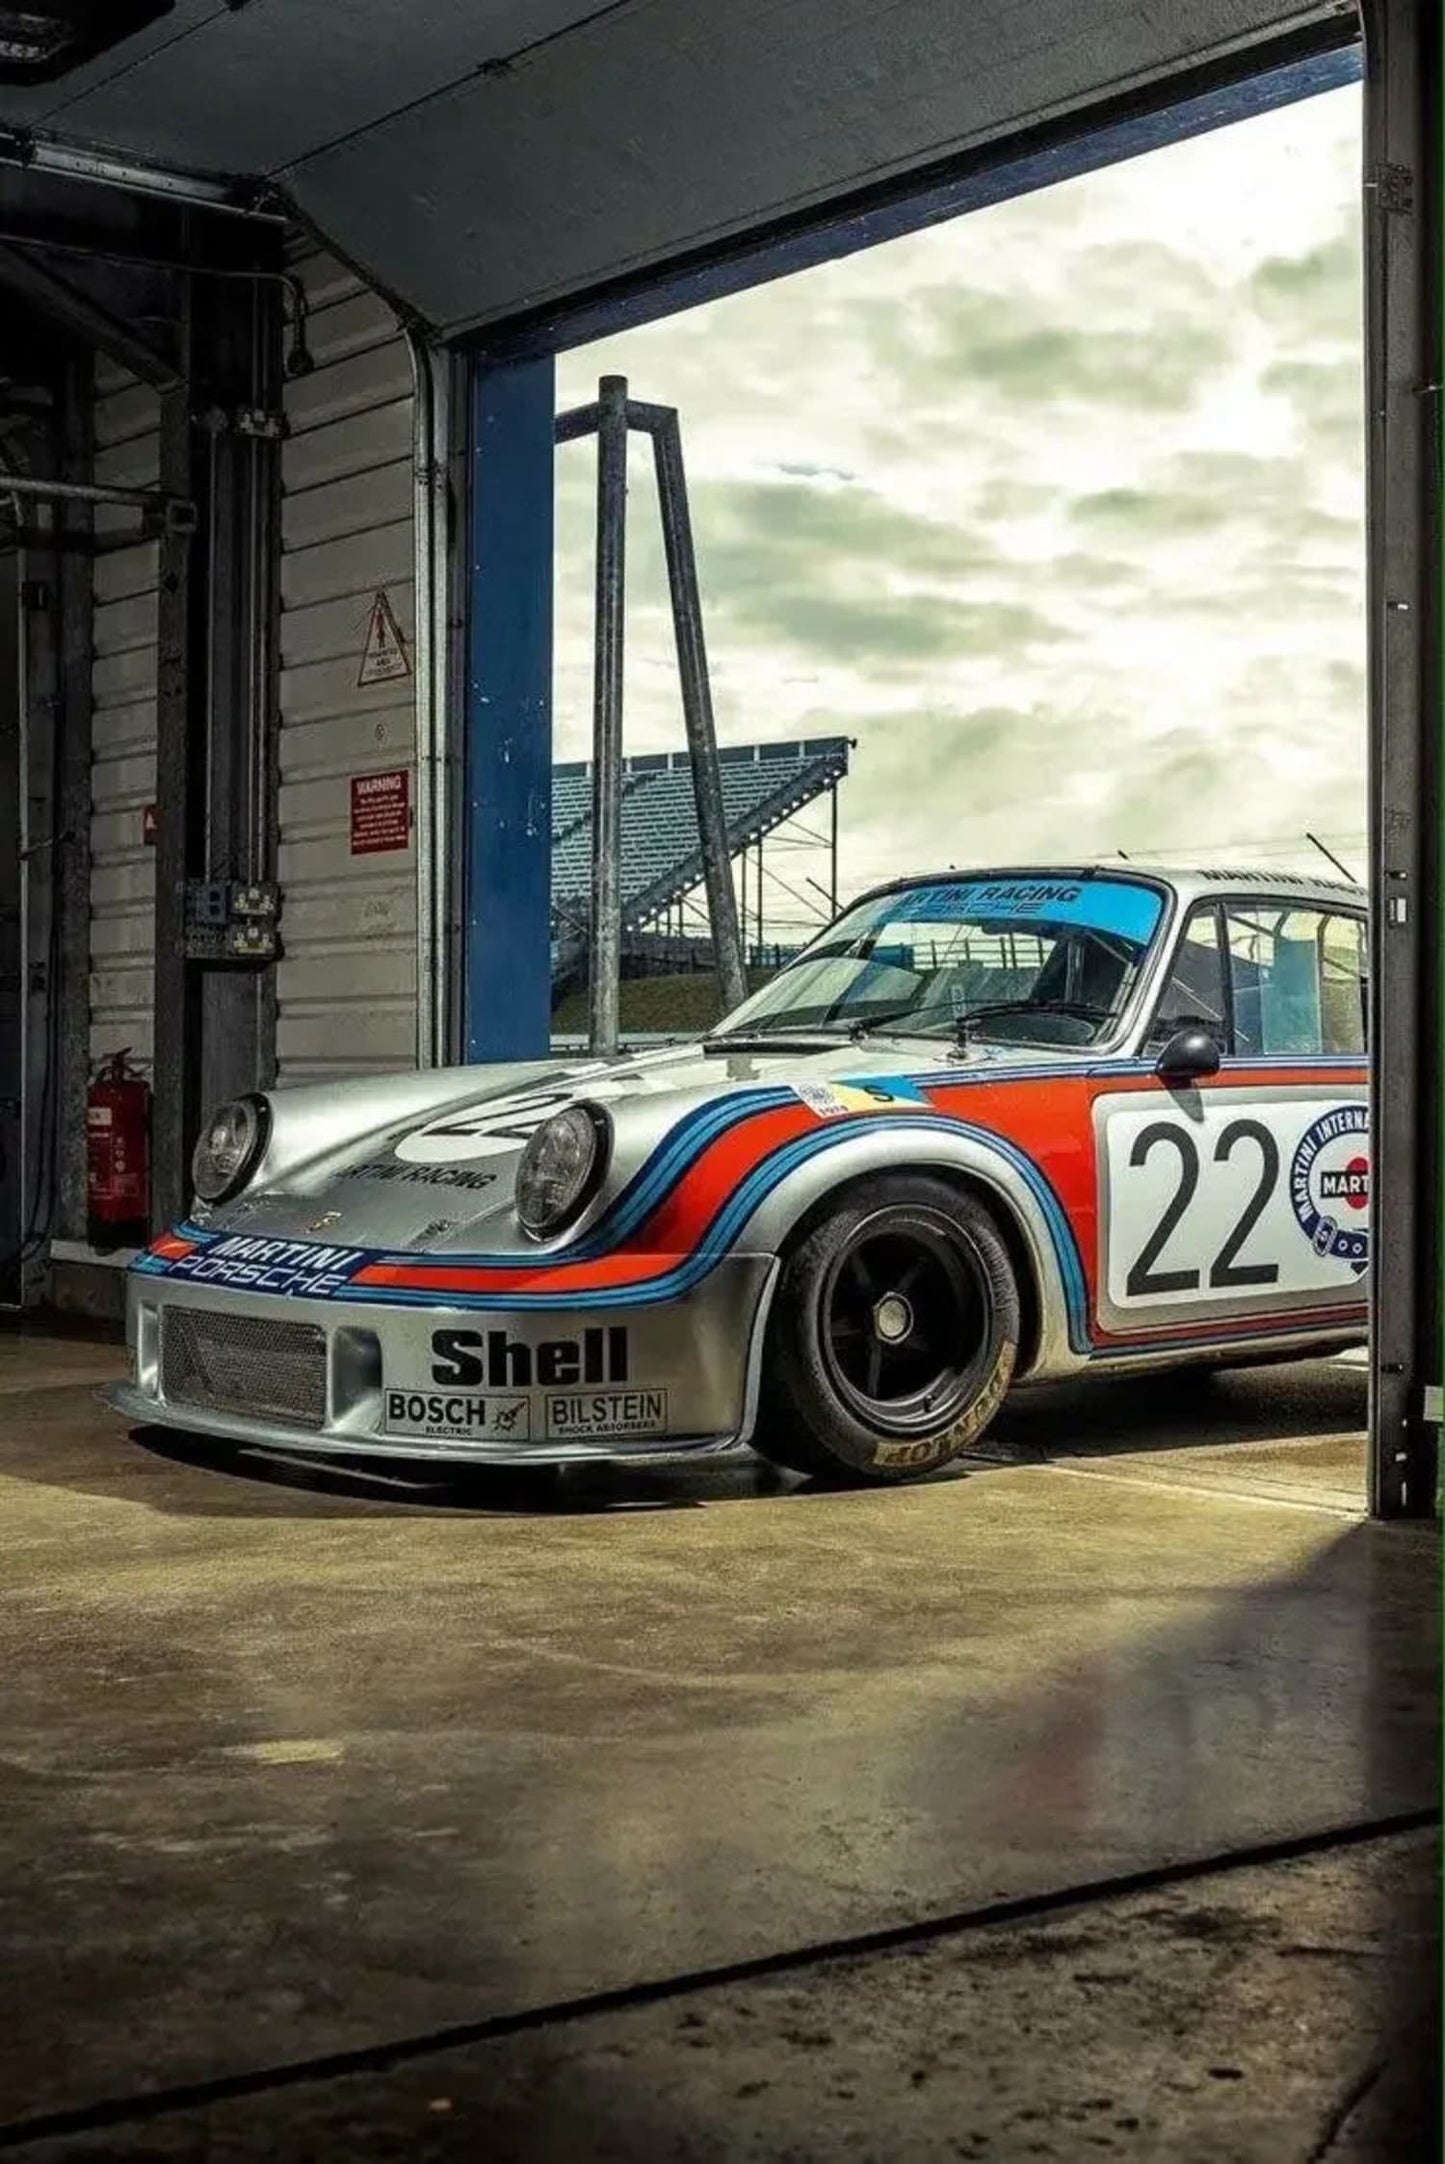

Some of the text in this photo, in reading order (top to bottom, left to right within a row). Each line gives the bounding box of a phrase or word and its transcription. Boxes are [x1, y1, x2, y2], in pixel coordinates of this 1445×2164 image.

[977, 885, 1084, 902] RACING
[400, 1164, 498, 1190] RACING
[1293, 1135, 1318, 1223] MARTINI
[1323, 1174, 1369, 1195] MART
[1126, 1118, 1280, 1297] 22
[207, 1235, 365, 1271] MARTINI
[168, 1254, 350, 1295] PORSCHE
[431, 1326, 628, 1387] Shell
[388, 1393, 486, 1427] BOSCH
[553, 1394, 662, 1426] BILSTEIN
